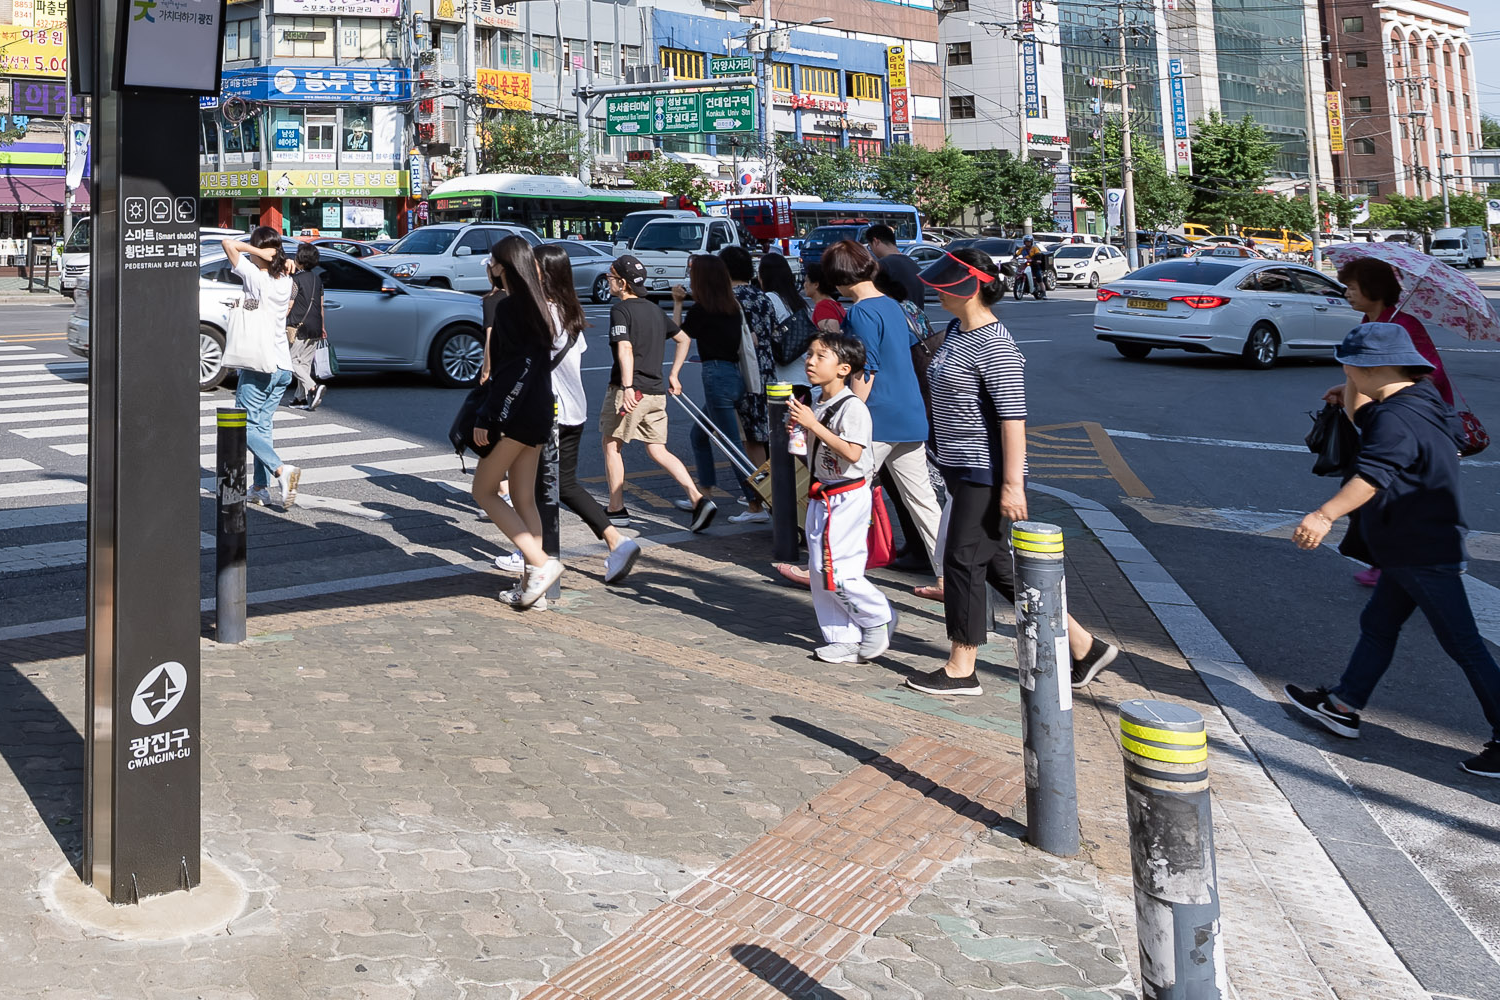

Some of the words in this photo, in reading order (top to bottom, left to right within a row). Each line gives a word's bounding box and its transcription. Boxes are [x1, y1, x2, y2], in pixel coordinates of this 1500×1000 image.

[14, 1, 33, 9] 8853
[37, 0, 67, 16] 파출부
[159, 10, 197, 24] 가치더하기
[198, 13, 213, 25] 광진
[22, 29, 63, 45] 이용원
[712, 58, 751, 71] 자양사거리
[481, 74, 530, 99] 성인용품점
[609, 100, 649, 113] 동서울터미널
[668, 97, 681, 107] 성남
[706, 96, 749, 108] 건대입구역
[665, 112, 699, 124] 잠실대교
[1028, 109, 1038, 117] 4F
[281, 130, 295, 139] 남성
[1176, 127, 1186, 136] 3F
[277, 138, 298, 147] 헤어컷
[200, 173, 260, 187] 시민동물병원
[306, 172, 398, 187] 시민동물병원
[125, 228, 155, 242] 스마트
[125, 244, 165, 259] 횡단보도
[167, 243, 197, 257] 그늘막
[129, 728, 190, 758] 광진구
[127, 748, 191, 770] GWANGJIN-GU
